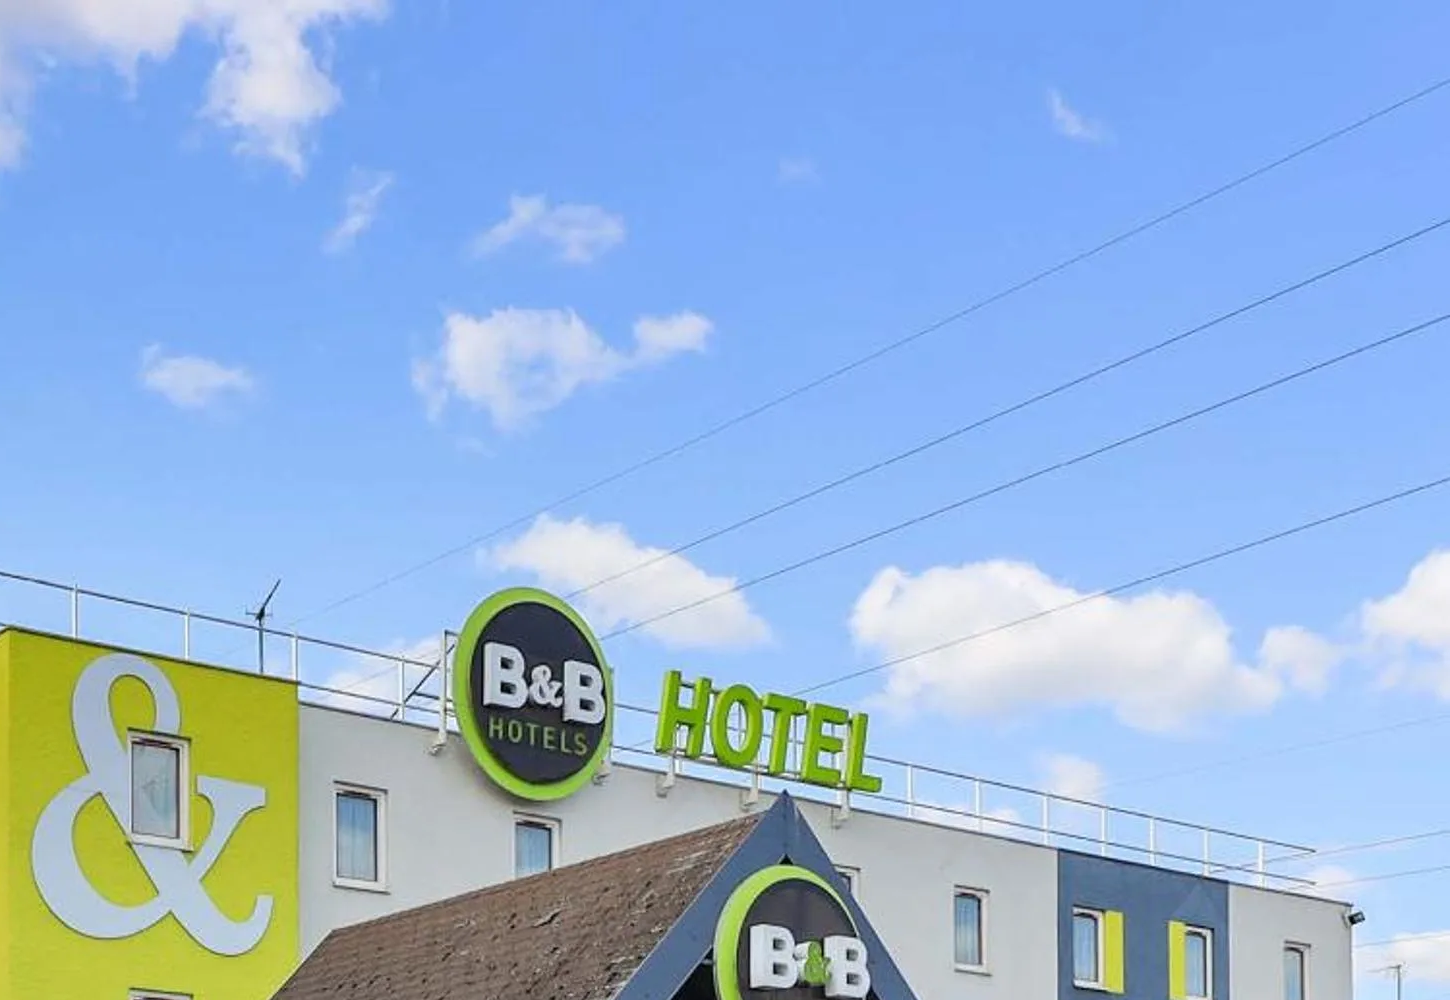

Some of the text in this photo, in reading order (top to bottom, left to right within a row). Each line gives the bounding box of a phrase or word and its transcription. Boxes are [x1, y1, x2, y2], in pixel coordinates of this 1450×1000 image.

[482, 641, 606, 725] B&B
[488, 716, 588, 756] HOTELS
[654, 669, 882, 793] HOTEL
[750, 923, 871, 999] B&B
